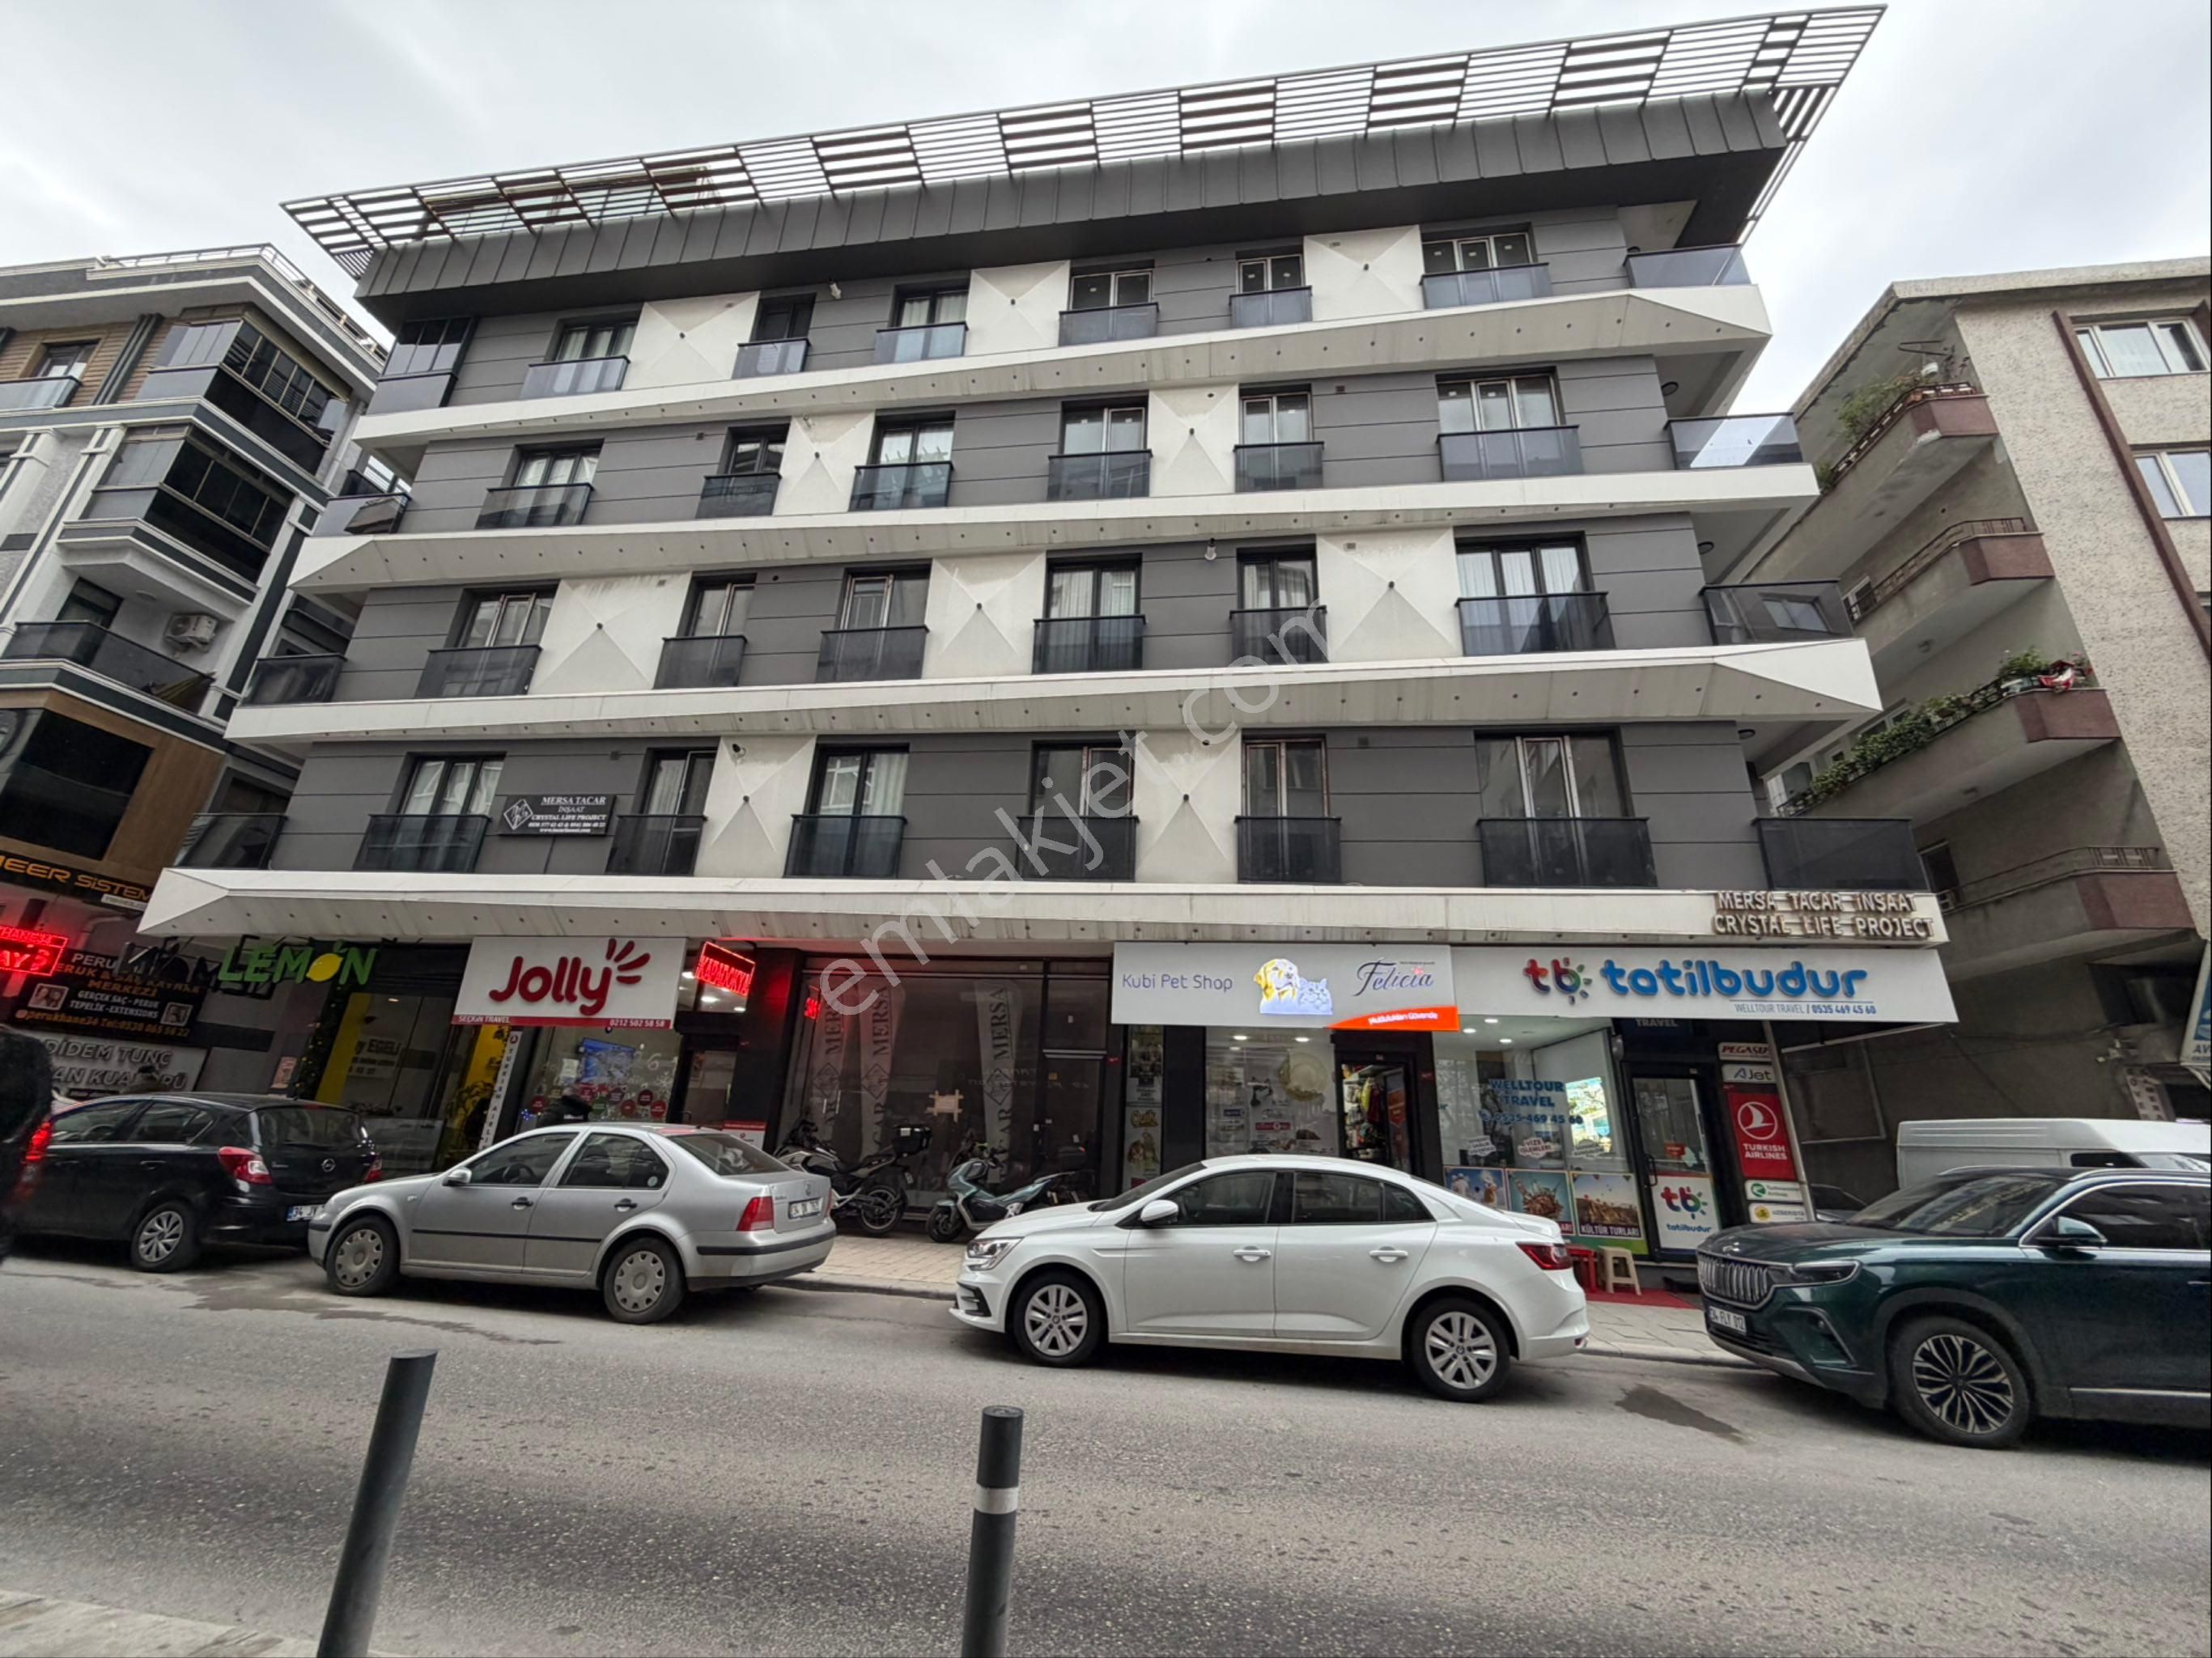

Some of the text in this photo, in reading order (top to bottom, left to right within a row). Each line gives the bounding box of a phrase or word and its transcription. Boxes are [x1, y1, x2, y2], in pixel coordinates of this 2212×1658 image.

[541, 796, 606, 805] MERSA TACAR
[0, 855, 71, 884] EER
[1716, 892, 1778, 910] MERSA
[1788, 893, 1844, 911] TACAR
[1713, 914, 1935, 939] CRYSTAL LIFE PROJECT
[218, 942, 379, 986] LEMON
[1122, 973, 1233, 993] Kubi Pet Shop
[1353, 958, 1435, 996] Felicia
[1600, 959, 1868, 997] tatilbudur
[489, 956, 614, 1016] Jolly
[1734, 1003, 1774, 1013] WELLTOUR
[1776, 1003, 1804, 1014] TRAVEL
[485, 1016, 511, 1024] TRAVEL
[609, 1019, 627, 1027] 0212
[991, 986, 1011, 1061] MERSA
[1721, 1045, 1770, 1055] PEGASU
[1734, 1067, 1773, 1080] AJet
[1489, 1080, 1565, 1093] WELLTOUR
[1502, 1096, 1556, 1108] TRAVEL
[1743, 1143, 1786, 1152] TURKISH
[1744, 1151, 1788, 1161] AIRLINES
[1581, 1223, 1639, 1236] KÜLTÜR TURLARI
[1665, 1223, 1711, 1233] tatilbudur
